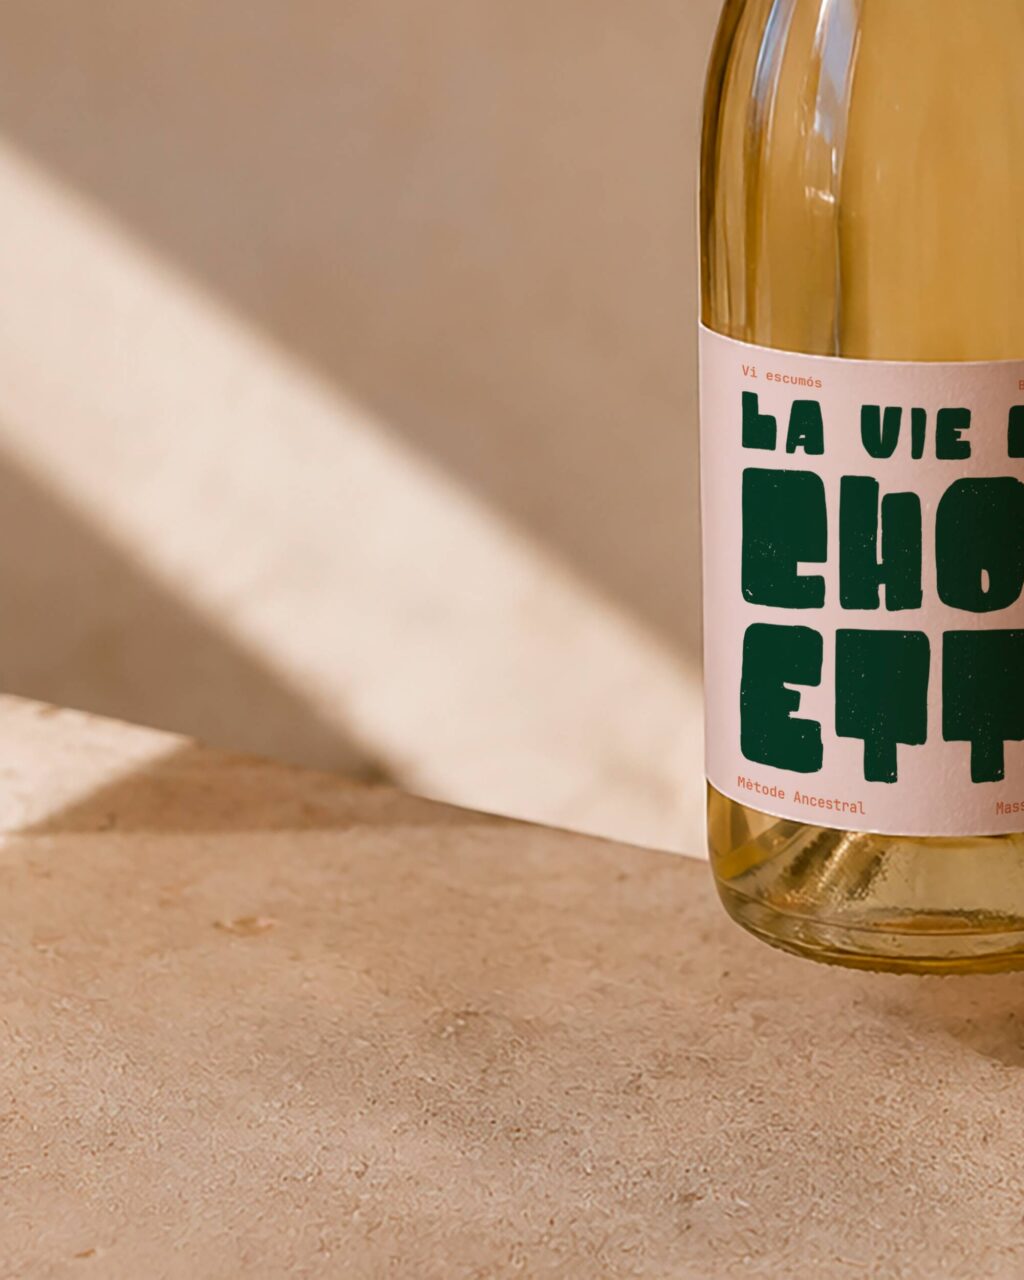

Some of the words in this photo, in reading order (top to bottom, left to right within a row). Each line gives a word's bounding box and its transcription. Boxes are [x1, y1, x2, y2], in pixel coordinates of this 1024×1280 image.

[741, 364, 758, 379] Vi
[765, 371, 823, 389] escumós
[741, 391, 825, 456] LA
[860, 404, 971, 460] VIE
[737, 775, 785, 800] Mètode
[793, 791, 866, 816] Ancestral
